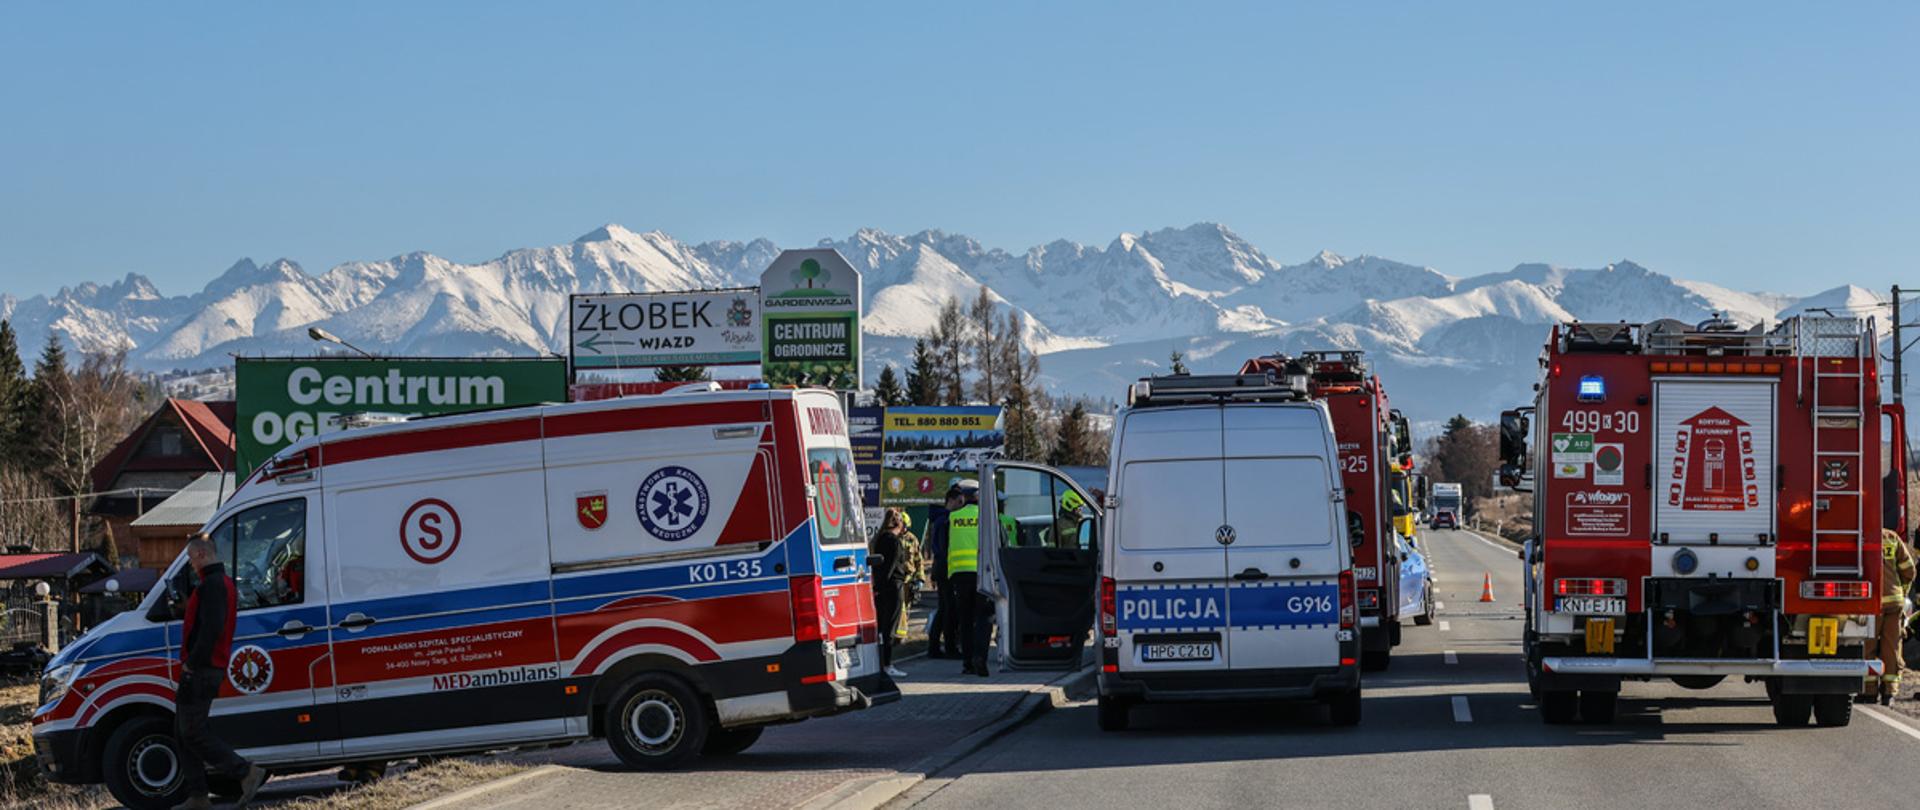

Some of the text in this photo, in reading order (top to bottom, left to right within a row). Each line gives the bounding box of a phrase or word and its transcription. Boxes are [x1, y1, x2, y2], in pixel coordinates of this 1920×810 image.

[765, 298, 852, 307] GARDENWIZJA
[577, 299, 713, 331] ŻŁOBEK
[774, 322, 846, 340] CENTRUM
[639, 336, 695, 349] WJAZD
[774, 343, 847, 357] OGRODNICZE
[287, 367, 505, 405] Centrum
[894, 418, 914, 426] TEL.
[917, 417, 937, 426] 880
[939, 417, 960, 426] 880
[1562, 410, 1600, 433] 499
[1614, 411, 1639, 433] 30
[1348, 456, 1368, 472] 25
[825, 476, 837, 512] S
[418, 512, 443, 551] S
[953, 518, 978, 527] POLICJ
[689, 560, 762, 583] K01-35
[1123, 596, 1332, 620] POLICJA G916
[1562, 599, 1623, 612] KNT EJ11
[418, 638, 449, 649] SZPITAL
[450, 629, 524, 646] SPECJALISTYCZNY
[1150, 645, 1211, 658] HPG C216
[432, 665, 559, 691] MEDambulans
